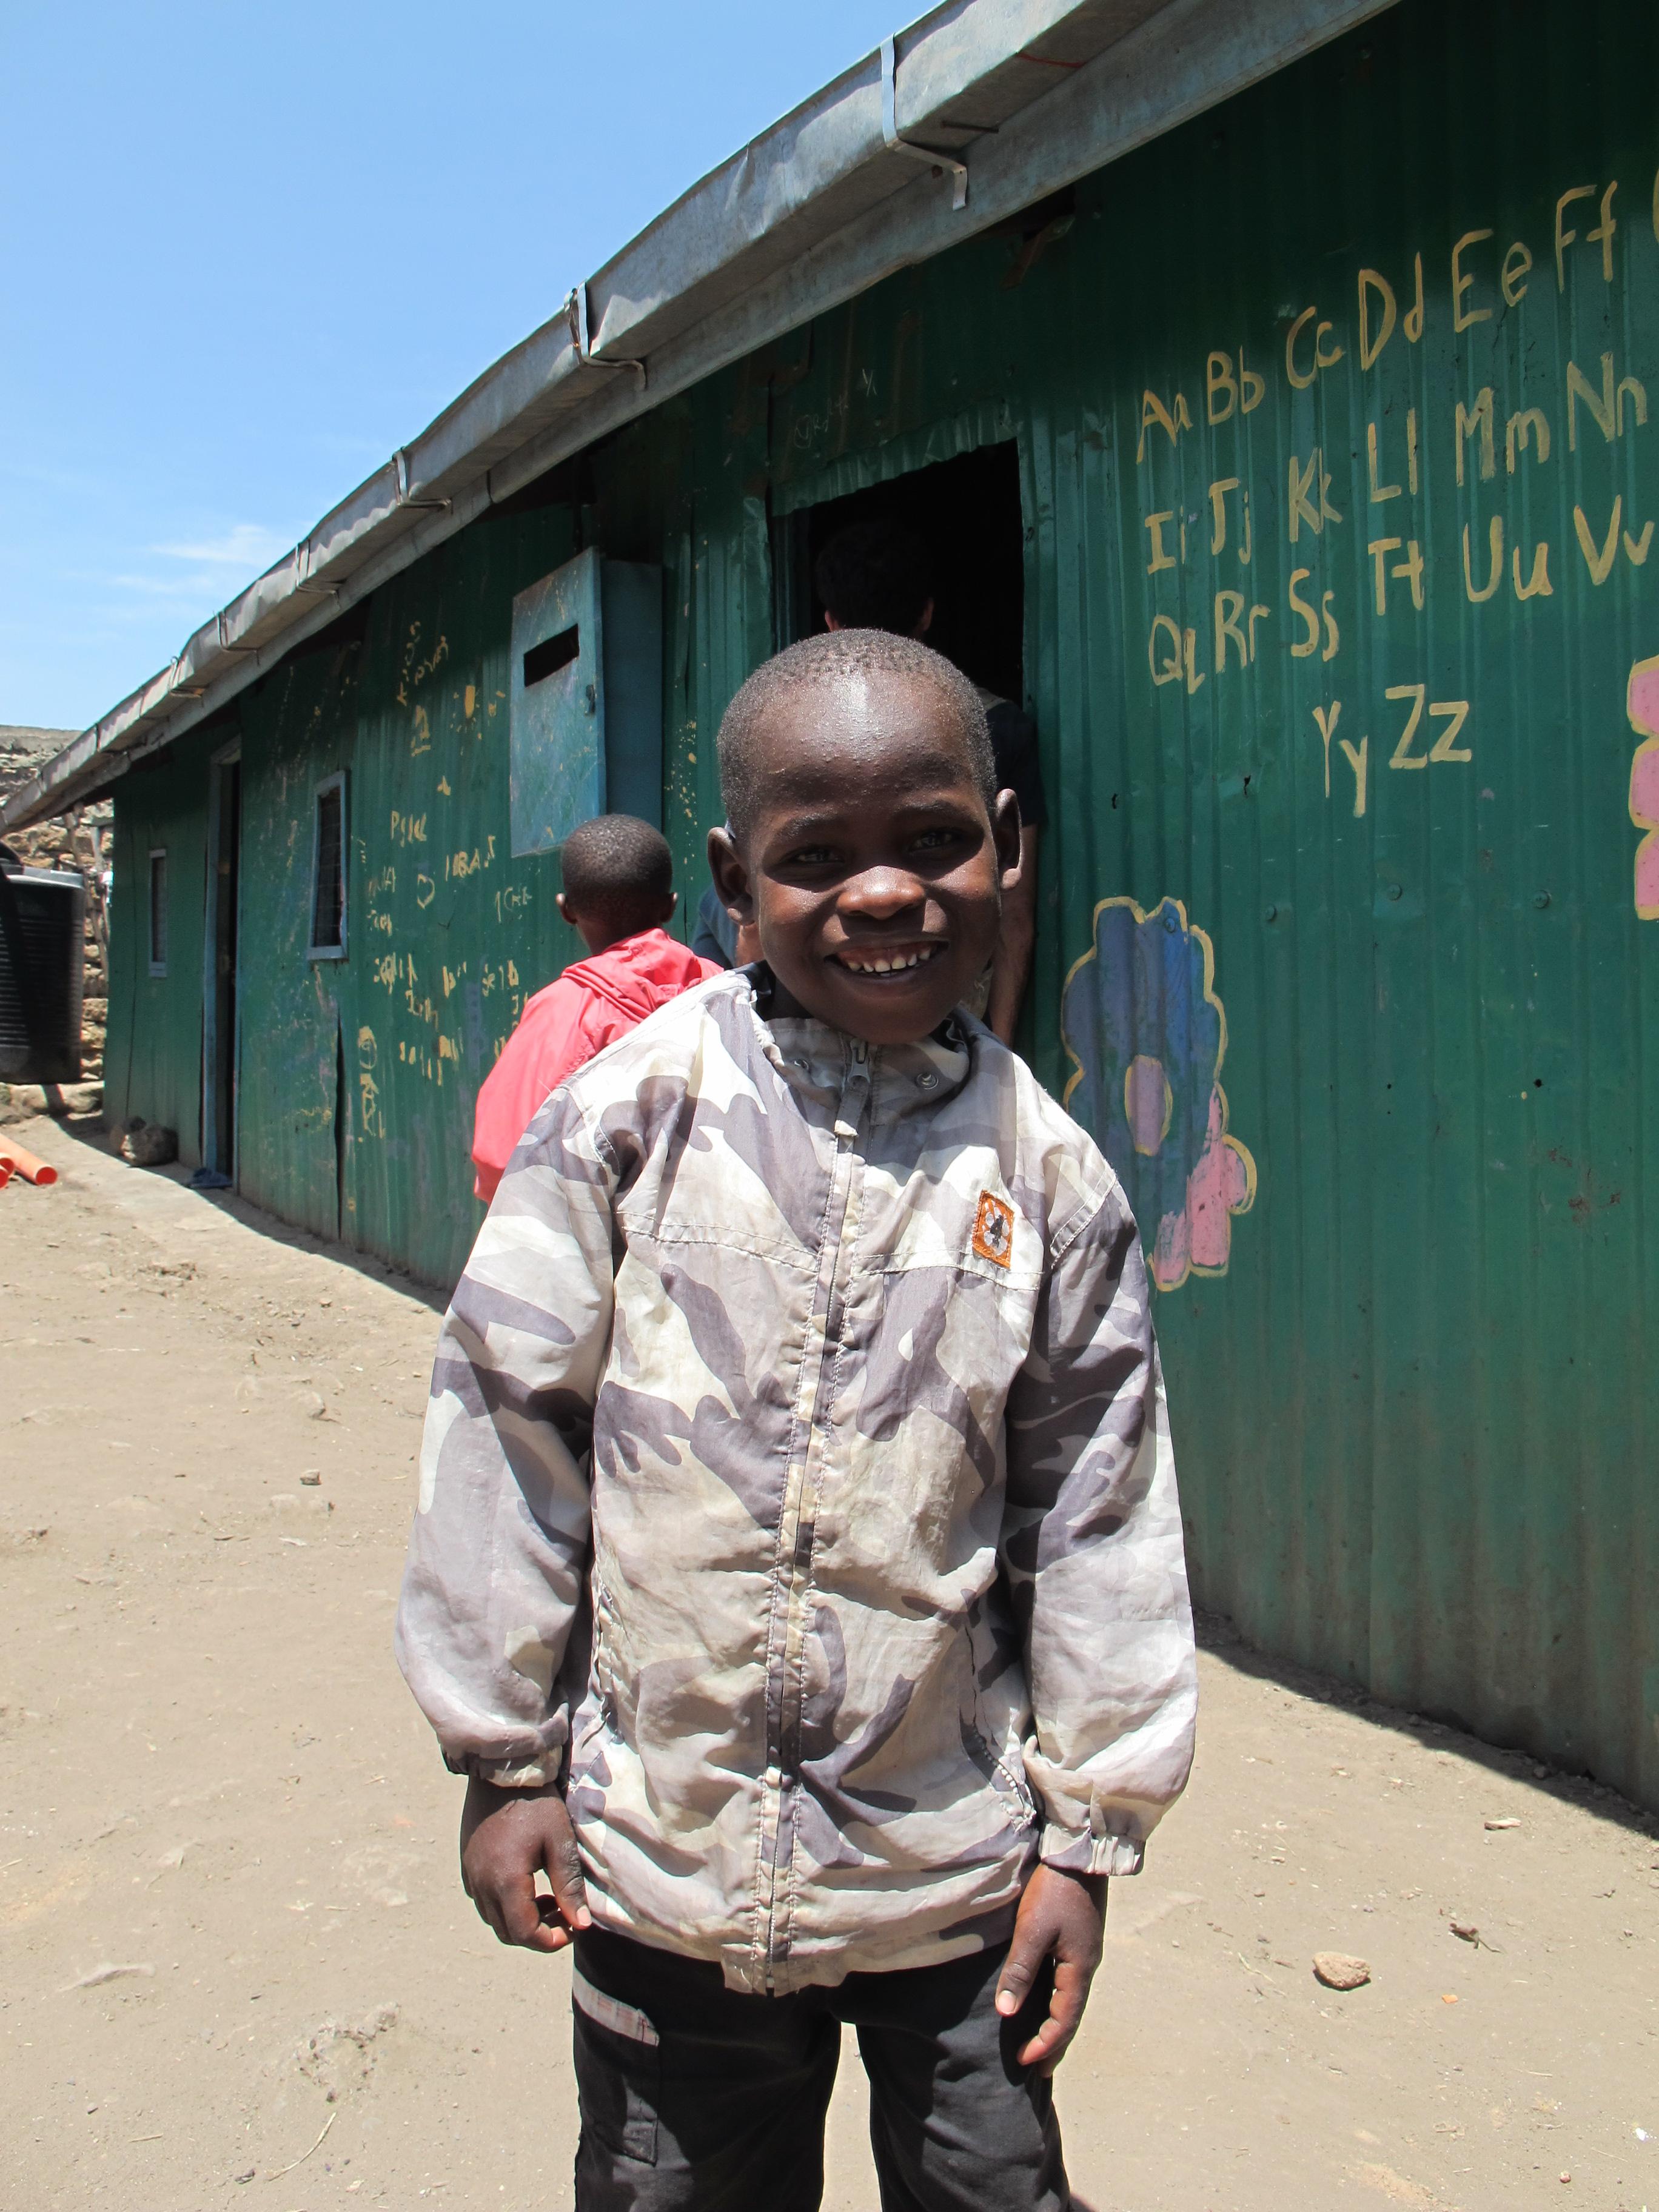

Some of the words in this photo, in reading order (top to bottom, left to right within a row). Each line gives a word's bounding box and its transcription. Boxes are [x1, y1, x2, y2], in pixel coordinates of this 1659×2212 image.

[1136, 389, 1193, 464] Aa
[1207, 346, 1265, 426] Bb
[1286, 306, 1346, 389] Cc
[1358, 252, 1423, 372] Dd
[1452, 228, 1532, 332] Ee
[1555, 180, 1618, 293] Ff
[1208, 477, 1252, 565] Jj
[1289, 447, 1342, 543] Kk
[1455, 387, 1551, 486] Mm
[1566, 351, 1647, 452] Nn
[1148, 614, 1205, 694] Qq
[1215, 590, 1271, 674] Rr
[1289, 568, 1339, 663] Ss
[1367, 537, 1426, 615] Tt
[1463, 515, 1553, 603] Uu
[1574, 495, 1655, 586] Vv
[1312, 700, 1368, 817] Yy
[1384, 683, 1472, 769] Zz
